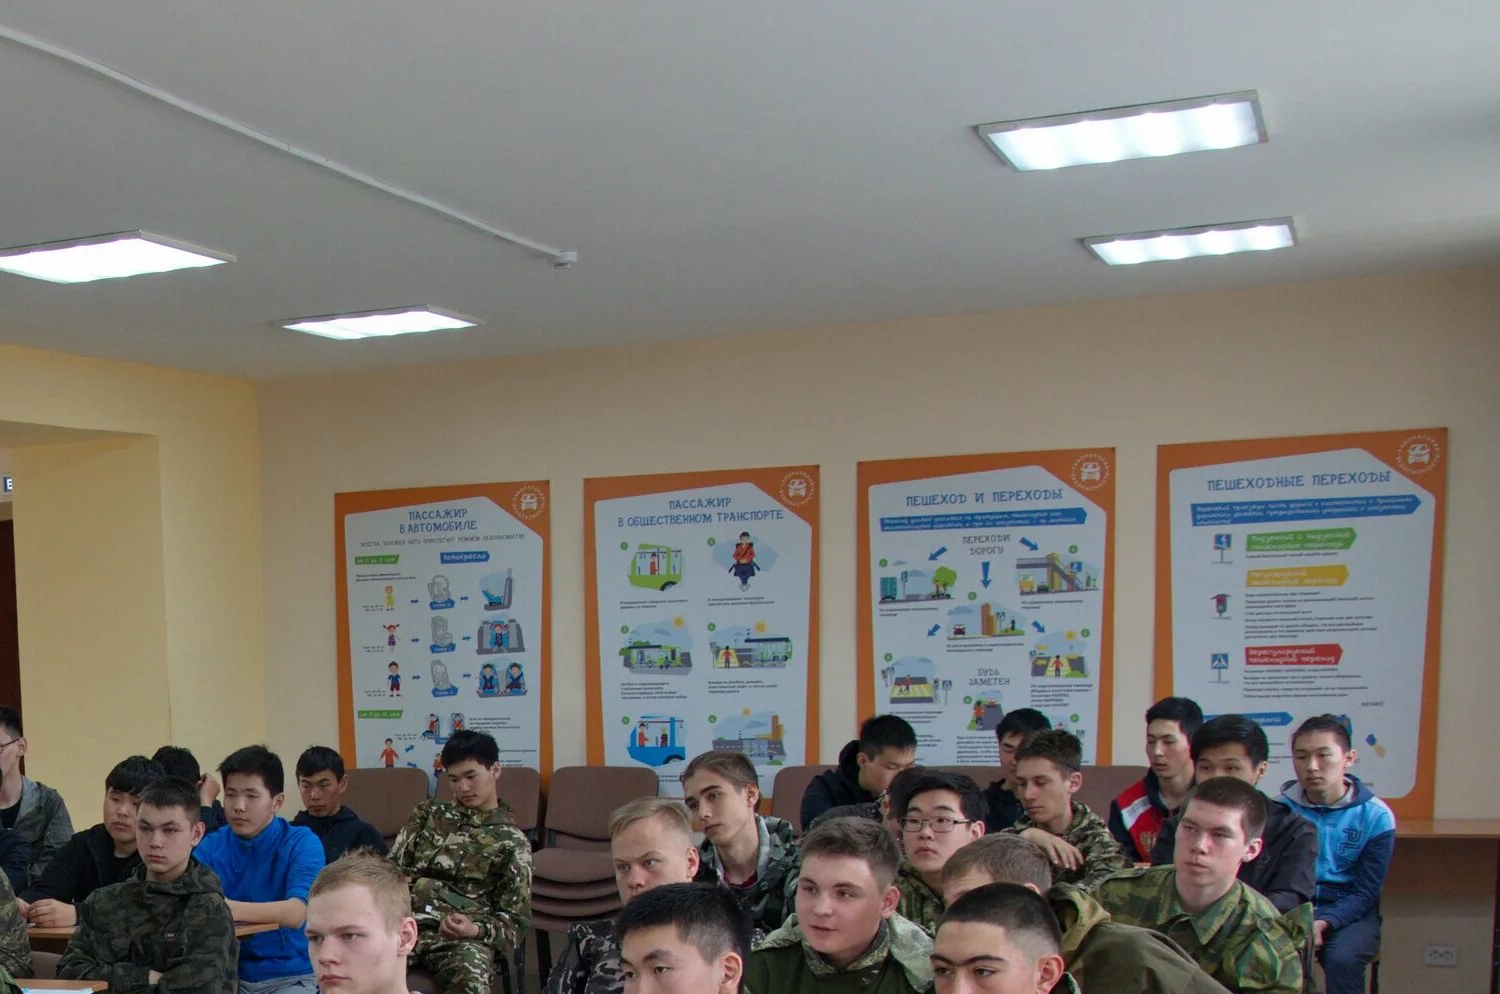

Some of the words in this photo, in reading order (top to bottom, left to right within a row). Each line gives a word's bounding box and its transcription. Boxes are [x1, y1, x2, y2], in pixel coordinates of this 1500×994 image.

[1207, 475, 1304, 491] ПЕШЕХОДНЫЕ
[1312, 470, 1391, 486] ПЕРЕХОДЫ
[906, 495, 967, 507] ПЕШЕХОД
[975, 493, 984, 503] И
[993, 488, 1063, 502] ПЕРЕХОДЫ
[669, 498, 731, 510] ПАССАЖИР
[409, 509, 468, 521] ПАССАЖИР
[618, 517, 624, 527] В
[627, 514, 712, 527] ОБЩЕСТВЕННОМ
[717, 509, 784, 521] ТРАНСПОРТЕ
[399, 524, 405, 534] В
[407, 520, 478, 533] АВТОМОБИЛЕ
[962, 534, 1010, 544] ПЕРЕХОДИ
[970, 547, 1004, 555] ДОРОГУ
[978, 668, 999, 676] БУДЬ
[968, 678, 1010, 686] ЗАМЕТЕН
